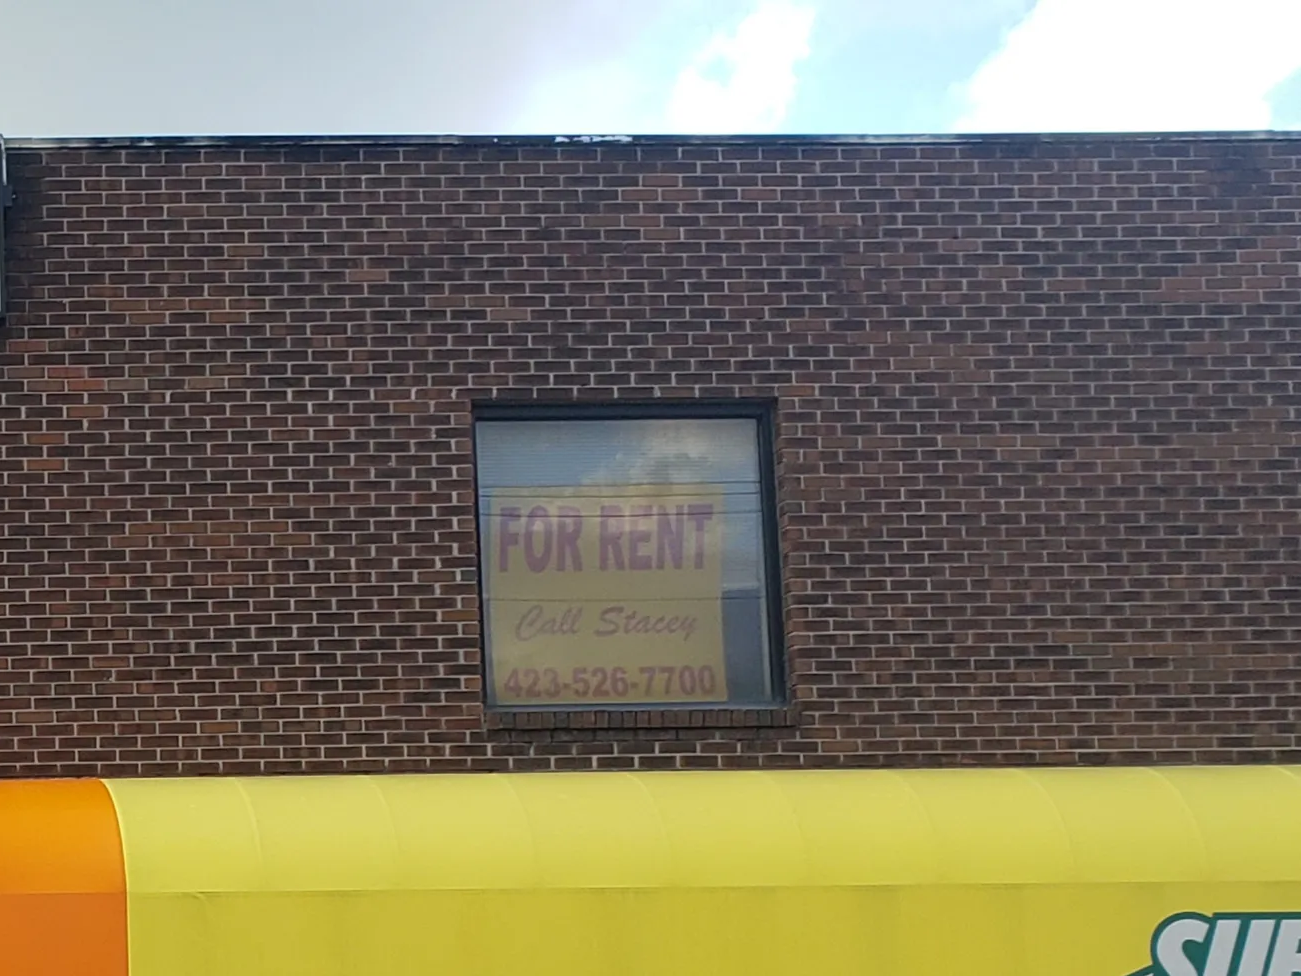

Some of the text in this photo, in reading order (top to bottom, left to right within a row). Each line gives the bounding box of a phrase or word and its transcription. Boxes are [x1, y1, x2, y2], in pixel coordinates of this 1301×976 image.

[499, 503, 715, 573] FOR RENT
[514, 604, 700, 642] Call Stacey
[503, 664, 717, 699] 423-526-7700
